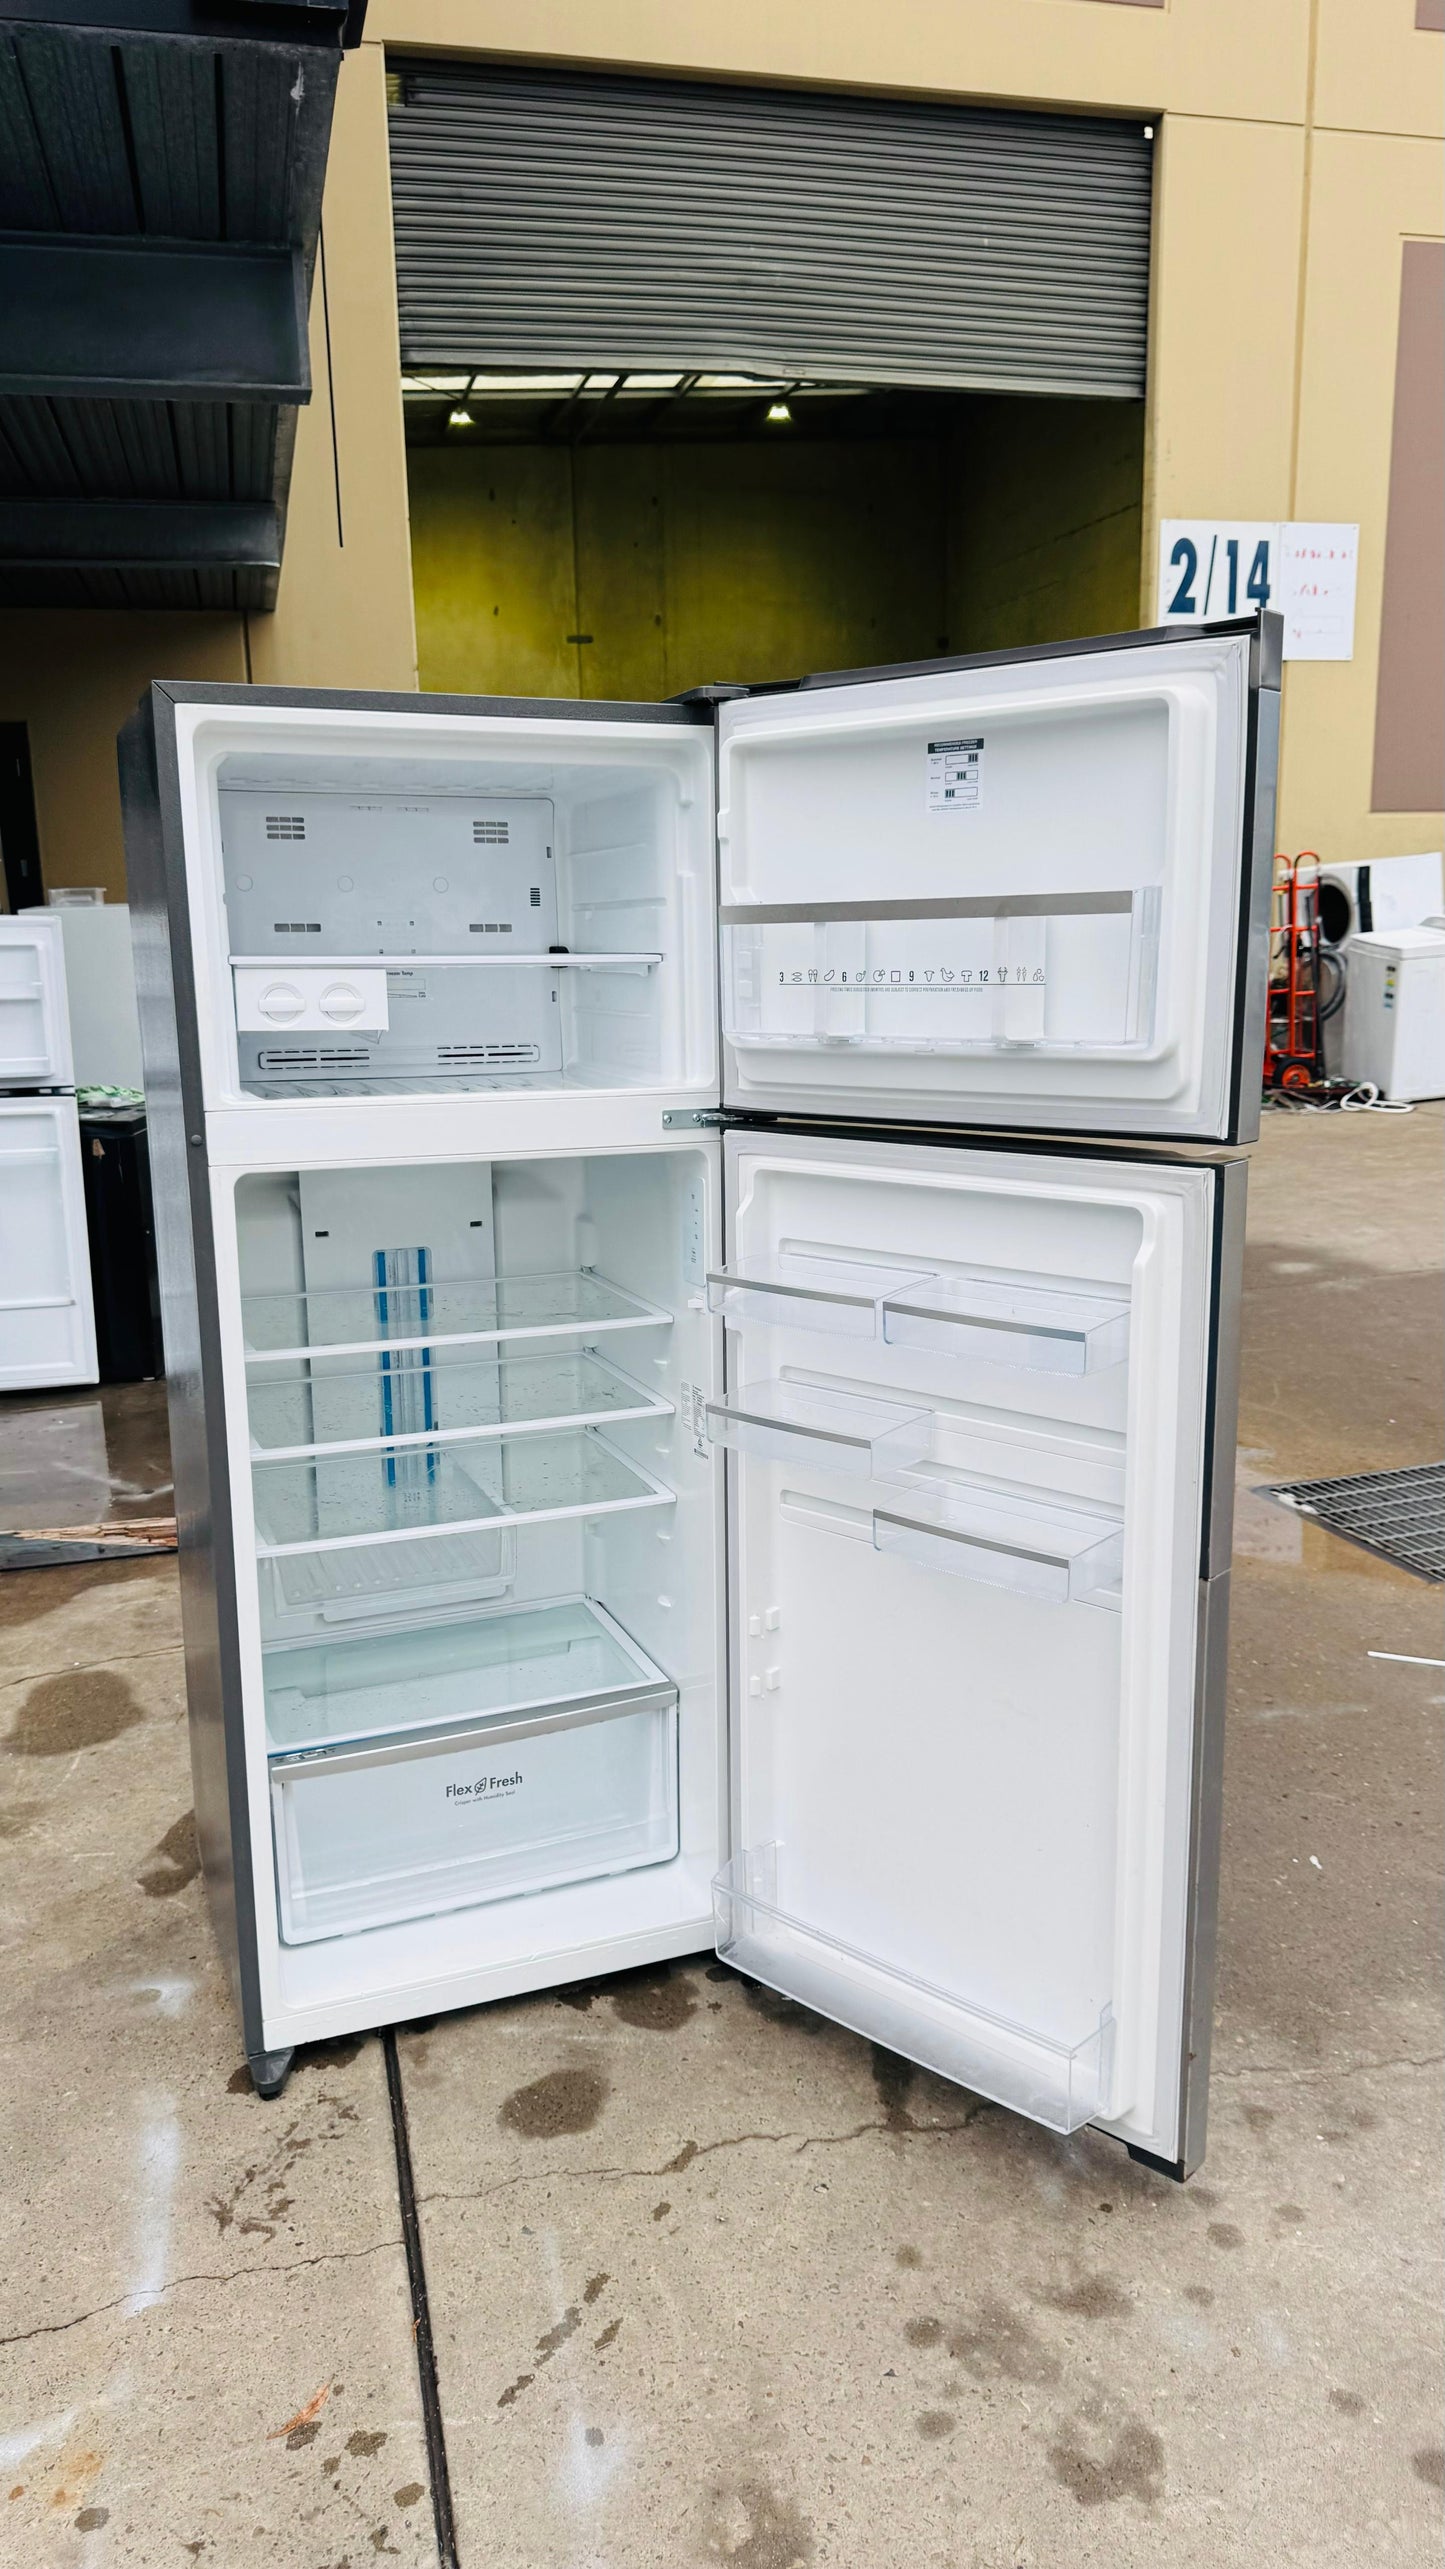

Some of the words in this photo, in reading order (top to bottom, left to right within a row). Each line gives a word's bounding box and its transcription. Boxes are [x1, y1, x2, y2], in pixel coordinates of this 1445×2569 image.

[1168, 535, 1271, 615] 2/14
[779, 971, 784, 982] 3
[842, 971, 847, 982] 6
[909, 970, 914, 981] 9
[980, 970, 989, 981] 12
[446, 1783, 473, 1798] Flex
[489, 1771, 523, 1789] Fresh
